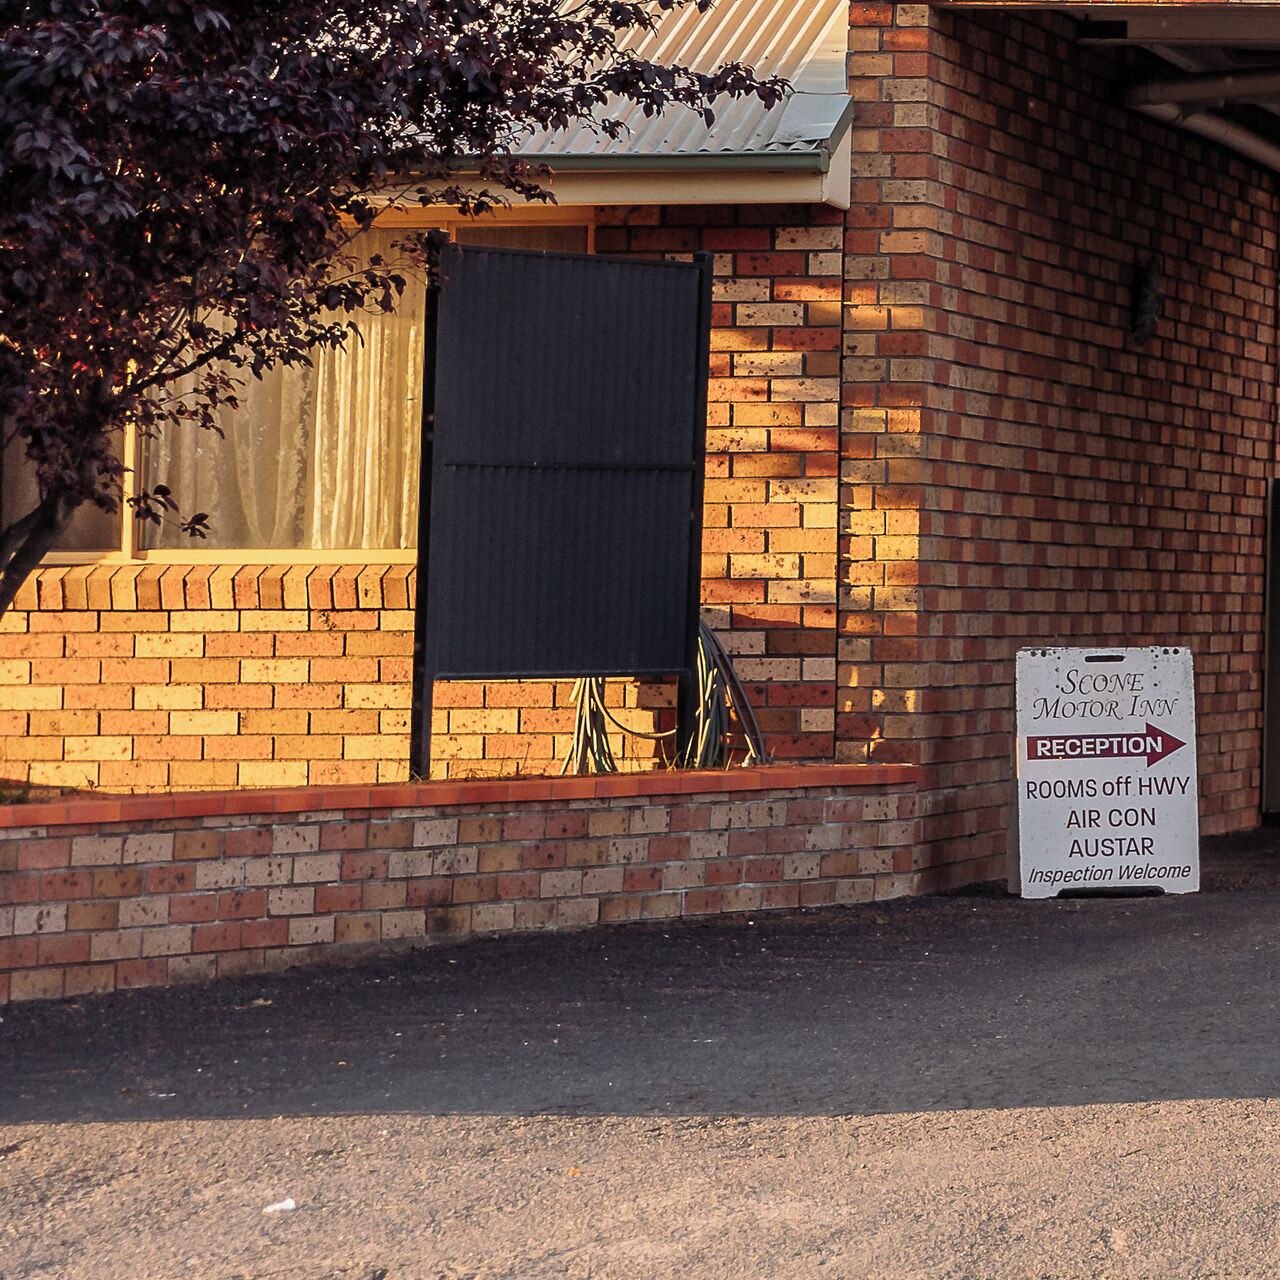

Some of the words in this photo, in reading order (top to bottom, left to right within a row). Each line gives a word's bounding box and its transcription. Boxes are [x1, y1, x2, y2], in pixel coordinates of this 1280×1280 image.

[1060, 669, 1145, 695] SCONE
[1032, 696, 1124, 721] MOTOR
[1128, 695, 1179, 717] INN
[1036, 736, 1163, 757] RECEPTION
[1026, 779, 1098, 800] ROOMS
[1102, 775, 1132, 796] off
[1138, 776, 1191, 796] HWY
[1066, 809, 1102, 829] AIR
[1108, 807, 1156, 827] CON
[1068, 837, 1154, 858] AUSTAR
[1028, 864, 1114, 887] Inspection
[1118, 862, 1192, 881] Welcome
